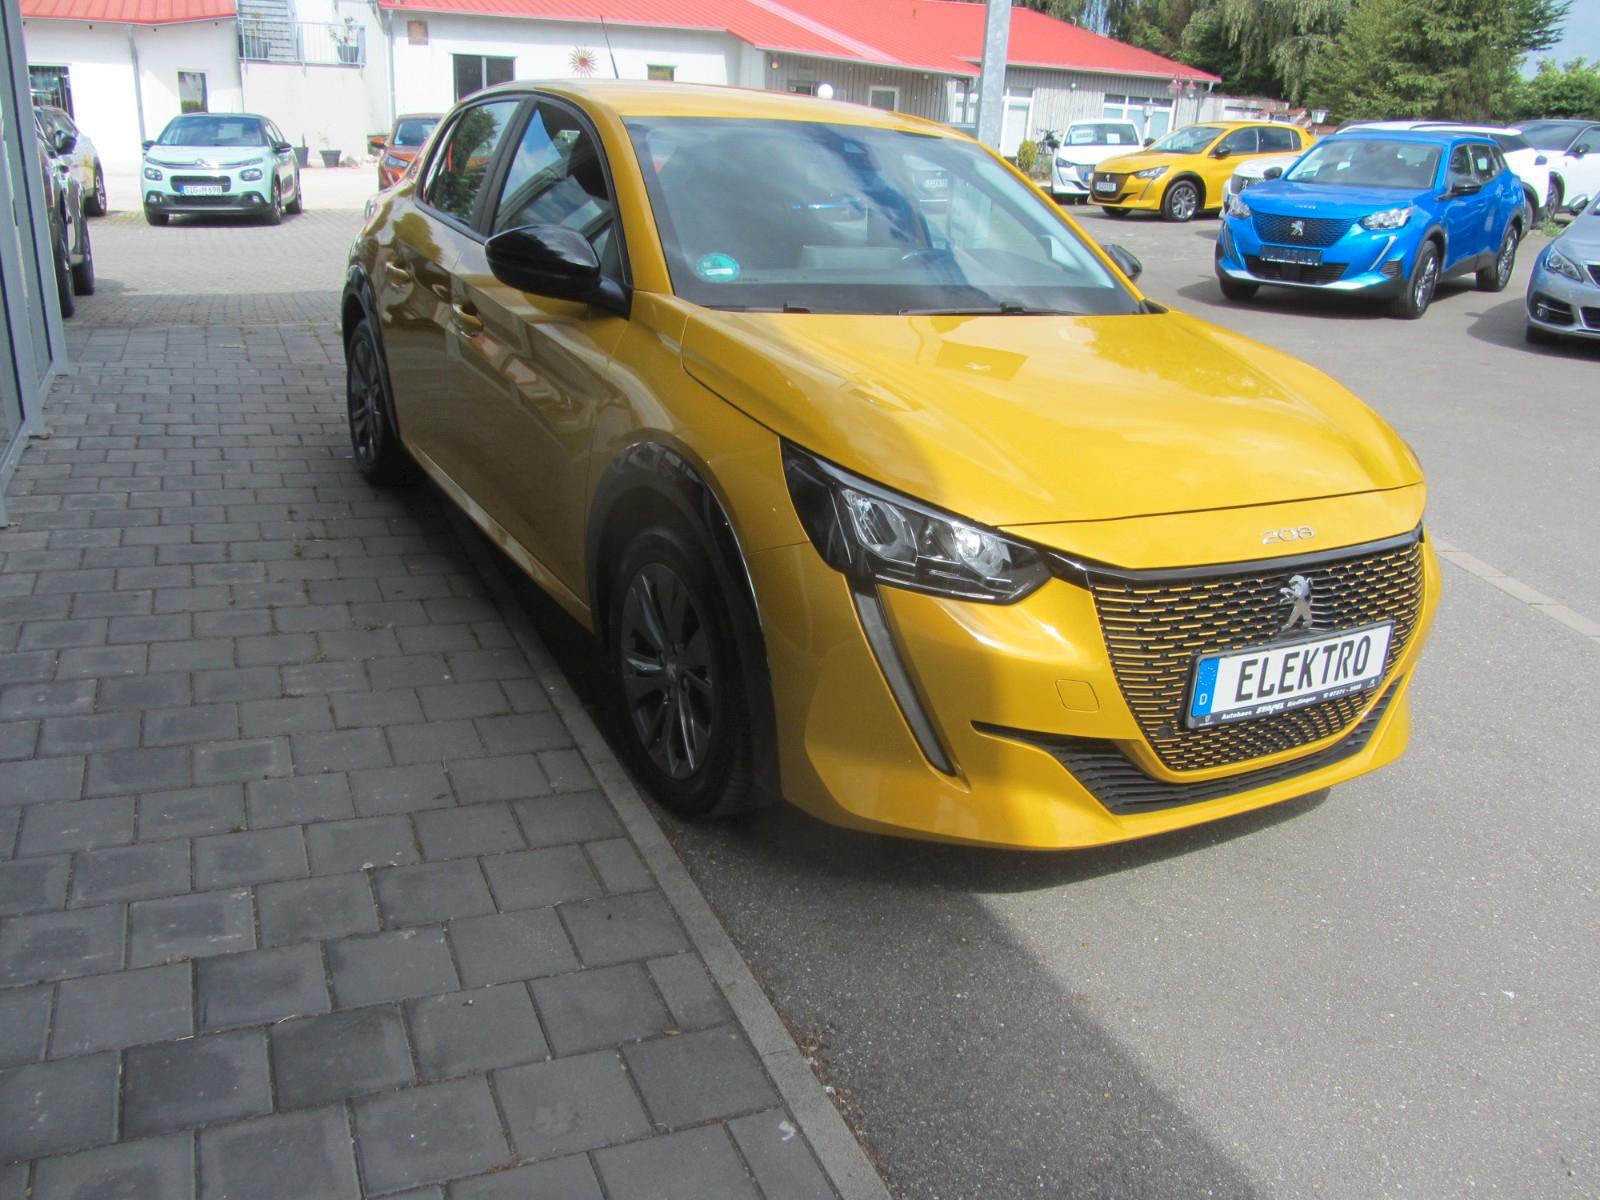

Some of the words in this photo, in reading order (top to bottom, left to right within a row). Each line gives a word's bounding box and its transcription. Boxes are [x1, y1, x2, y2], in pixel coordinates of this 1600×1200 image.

[1262, 526, 1314, 545] 208
[1235, 634, 1371, 702] ELEKTRO
[1198, 692, 1208, 706] D
